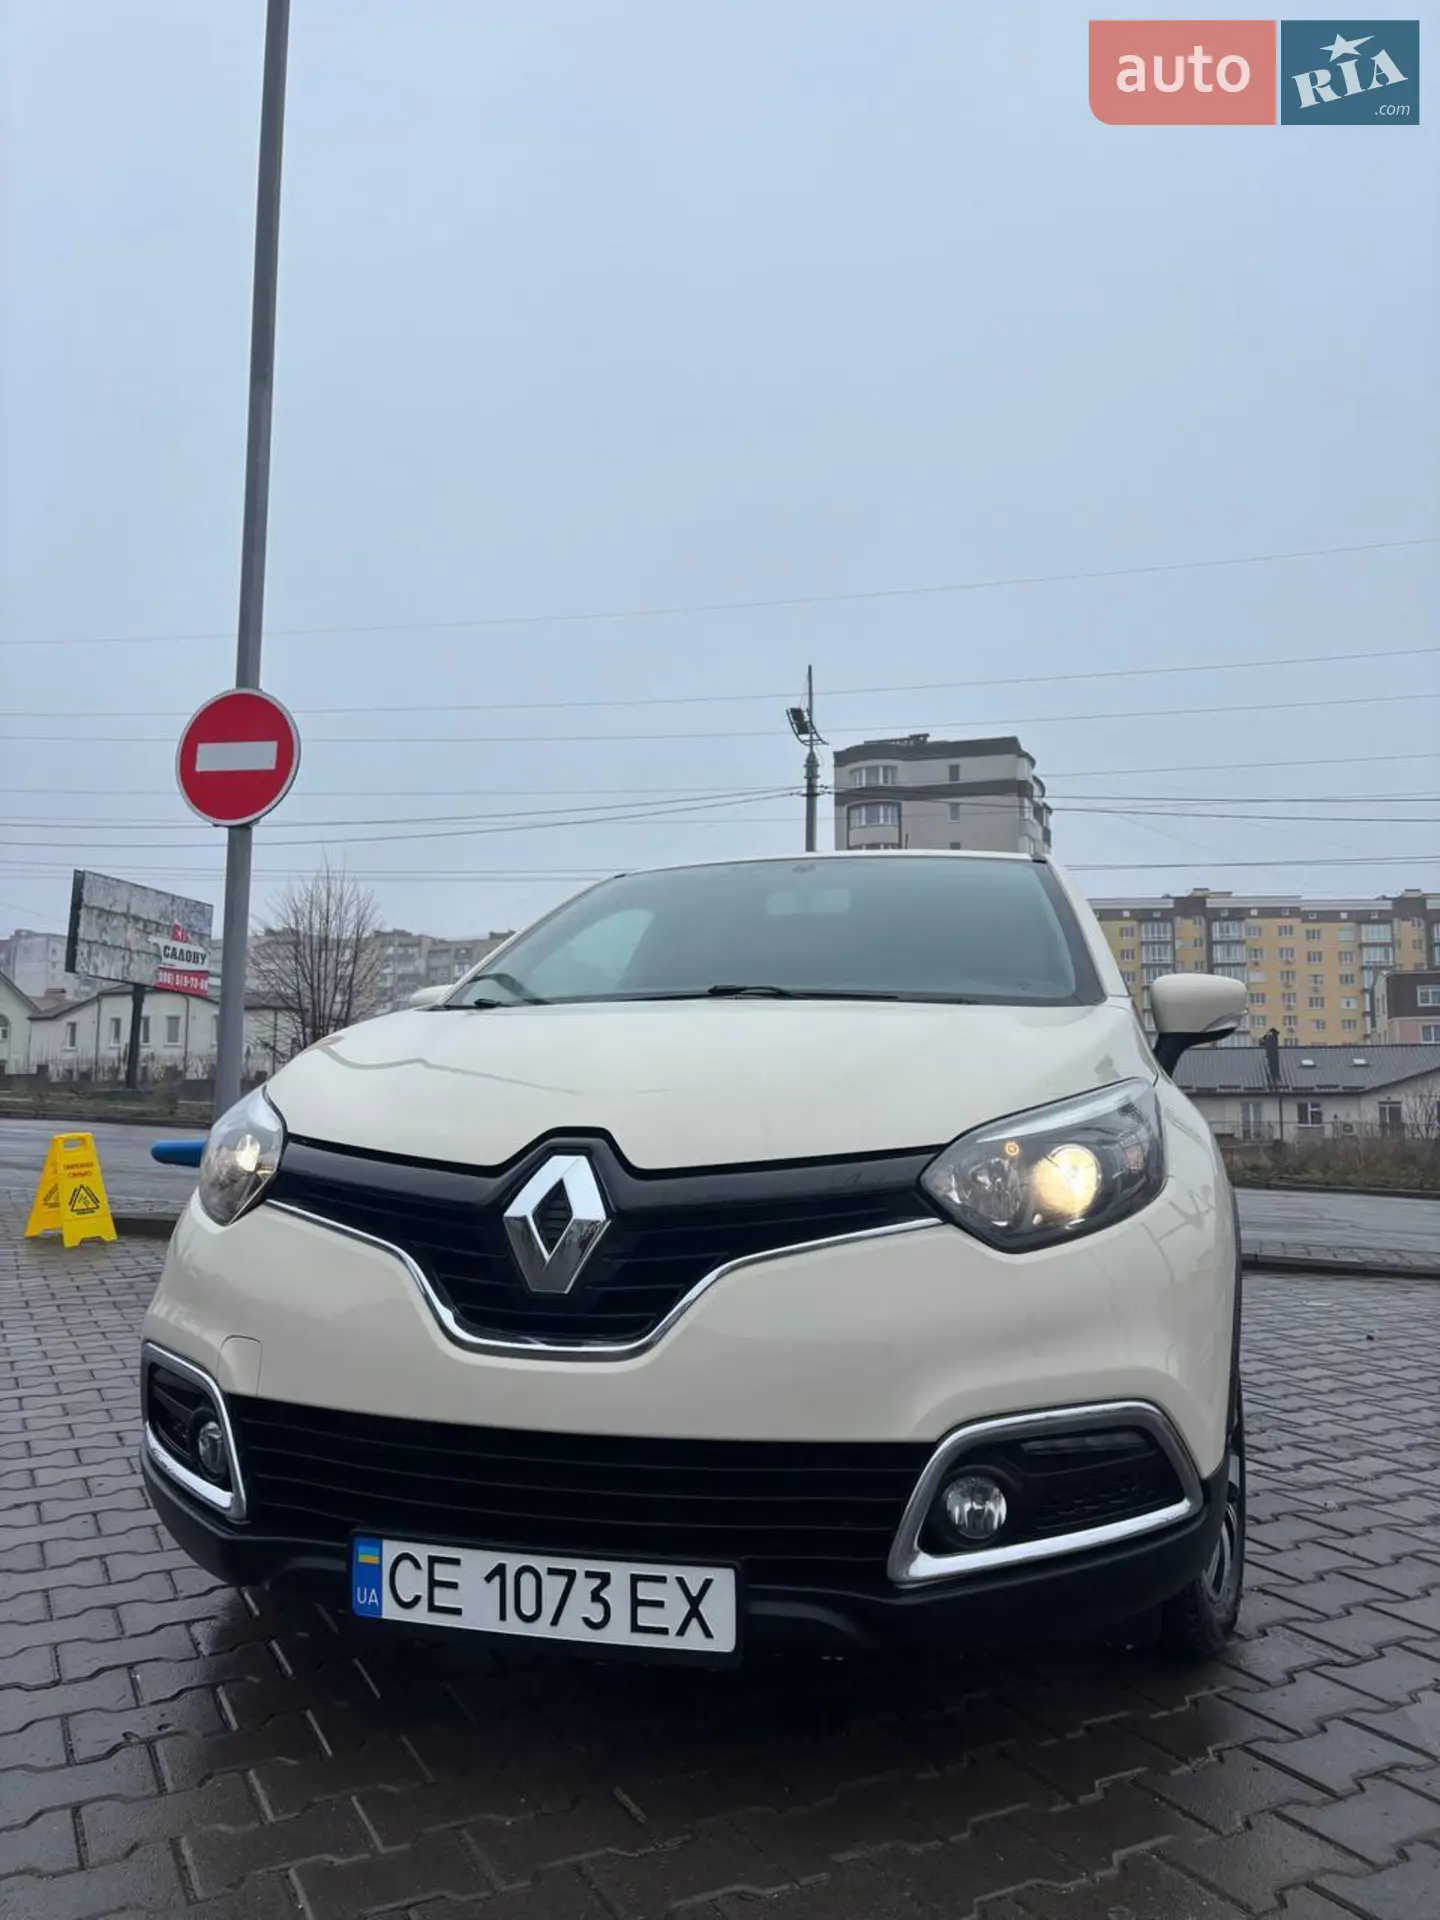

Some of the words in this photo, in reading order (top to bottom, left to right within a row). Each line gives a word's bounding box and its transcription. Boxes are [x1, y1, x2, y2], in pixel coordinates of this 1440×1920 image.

[356, 1587, 380, 1606] UA
[389, 1551, 463, 1616] CE
[483, 1562, 612, 1631] 1073
[630, 1573, 715, 1639] EX
